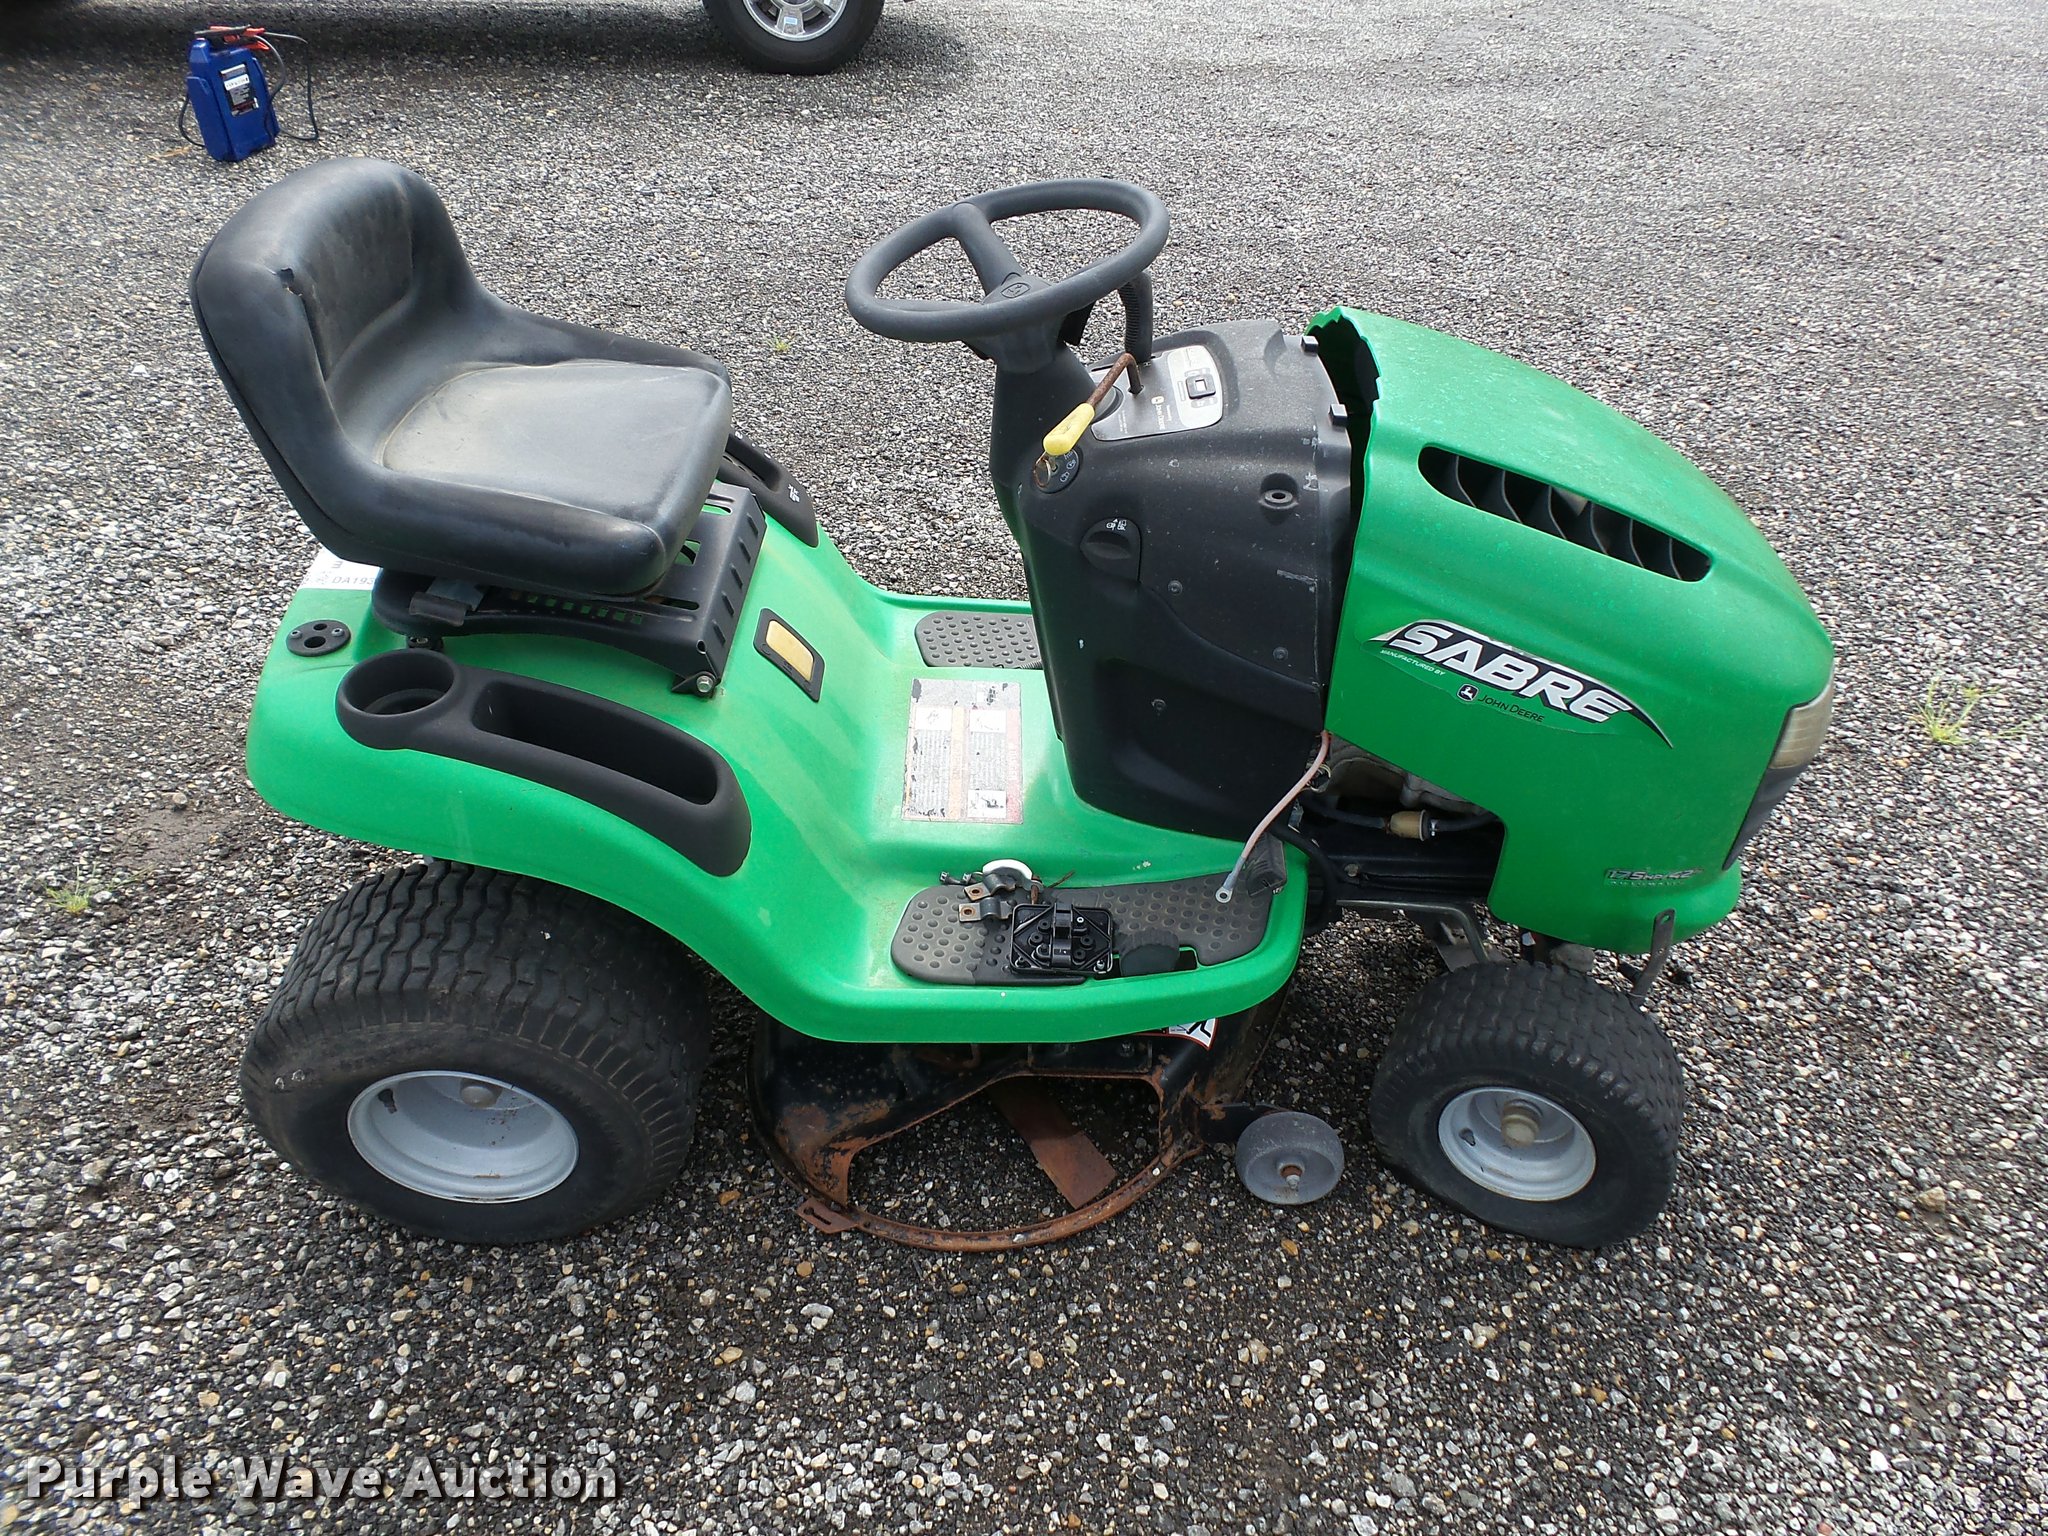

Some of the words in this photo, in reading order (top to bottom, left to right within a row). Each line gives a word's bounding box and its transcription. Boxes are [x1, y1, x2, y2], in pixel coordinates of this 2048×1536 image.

[1380, 650, 1435, 672] MANUFACTURED
[1388, 624, 1633, 723] SABRE
[1478, 695, 1510, 711] JOHN
[1509, 704, 1545, 723] DEERE
